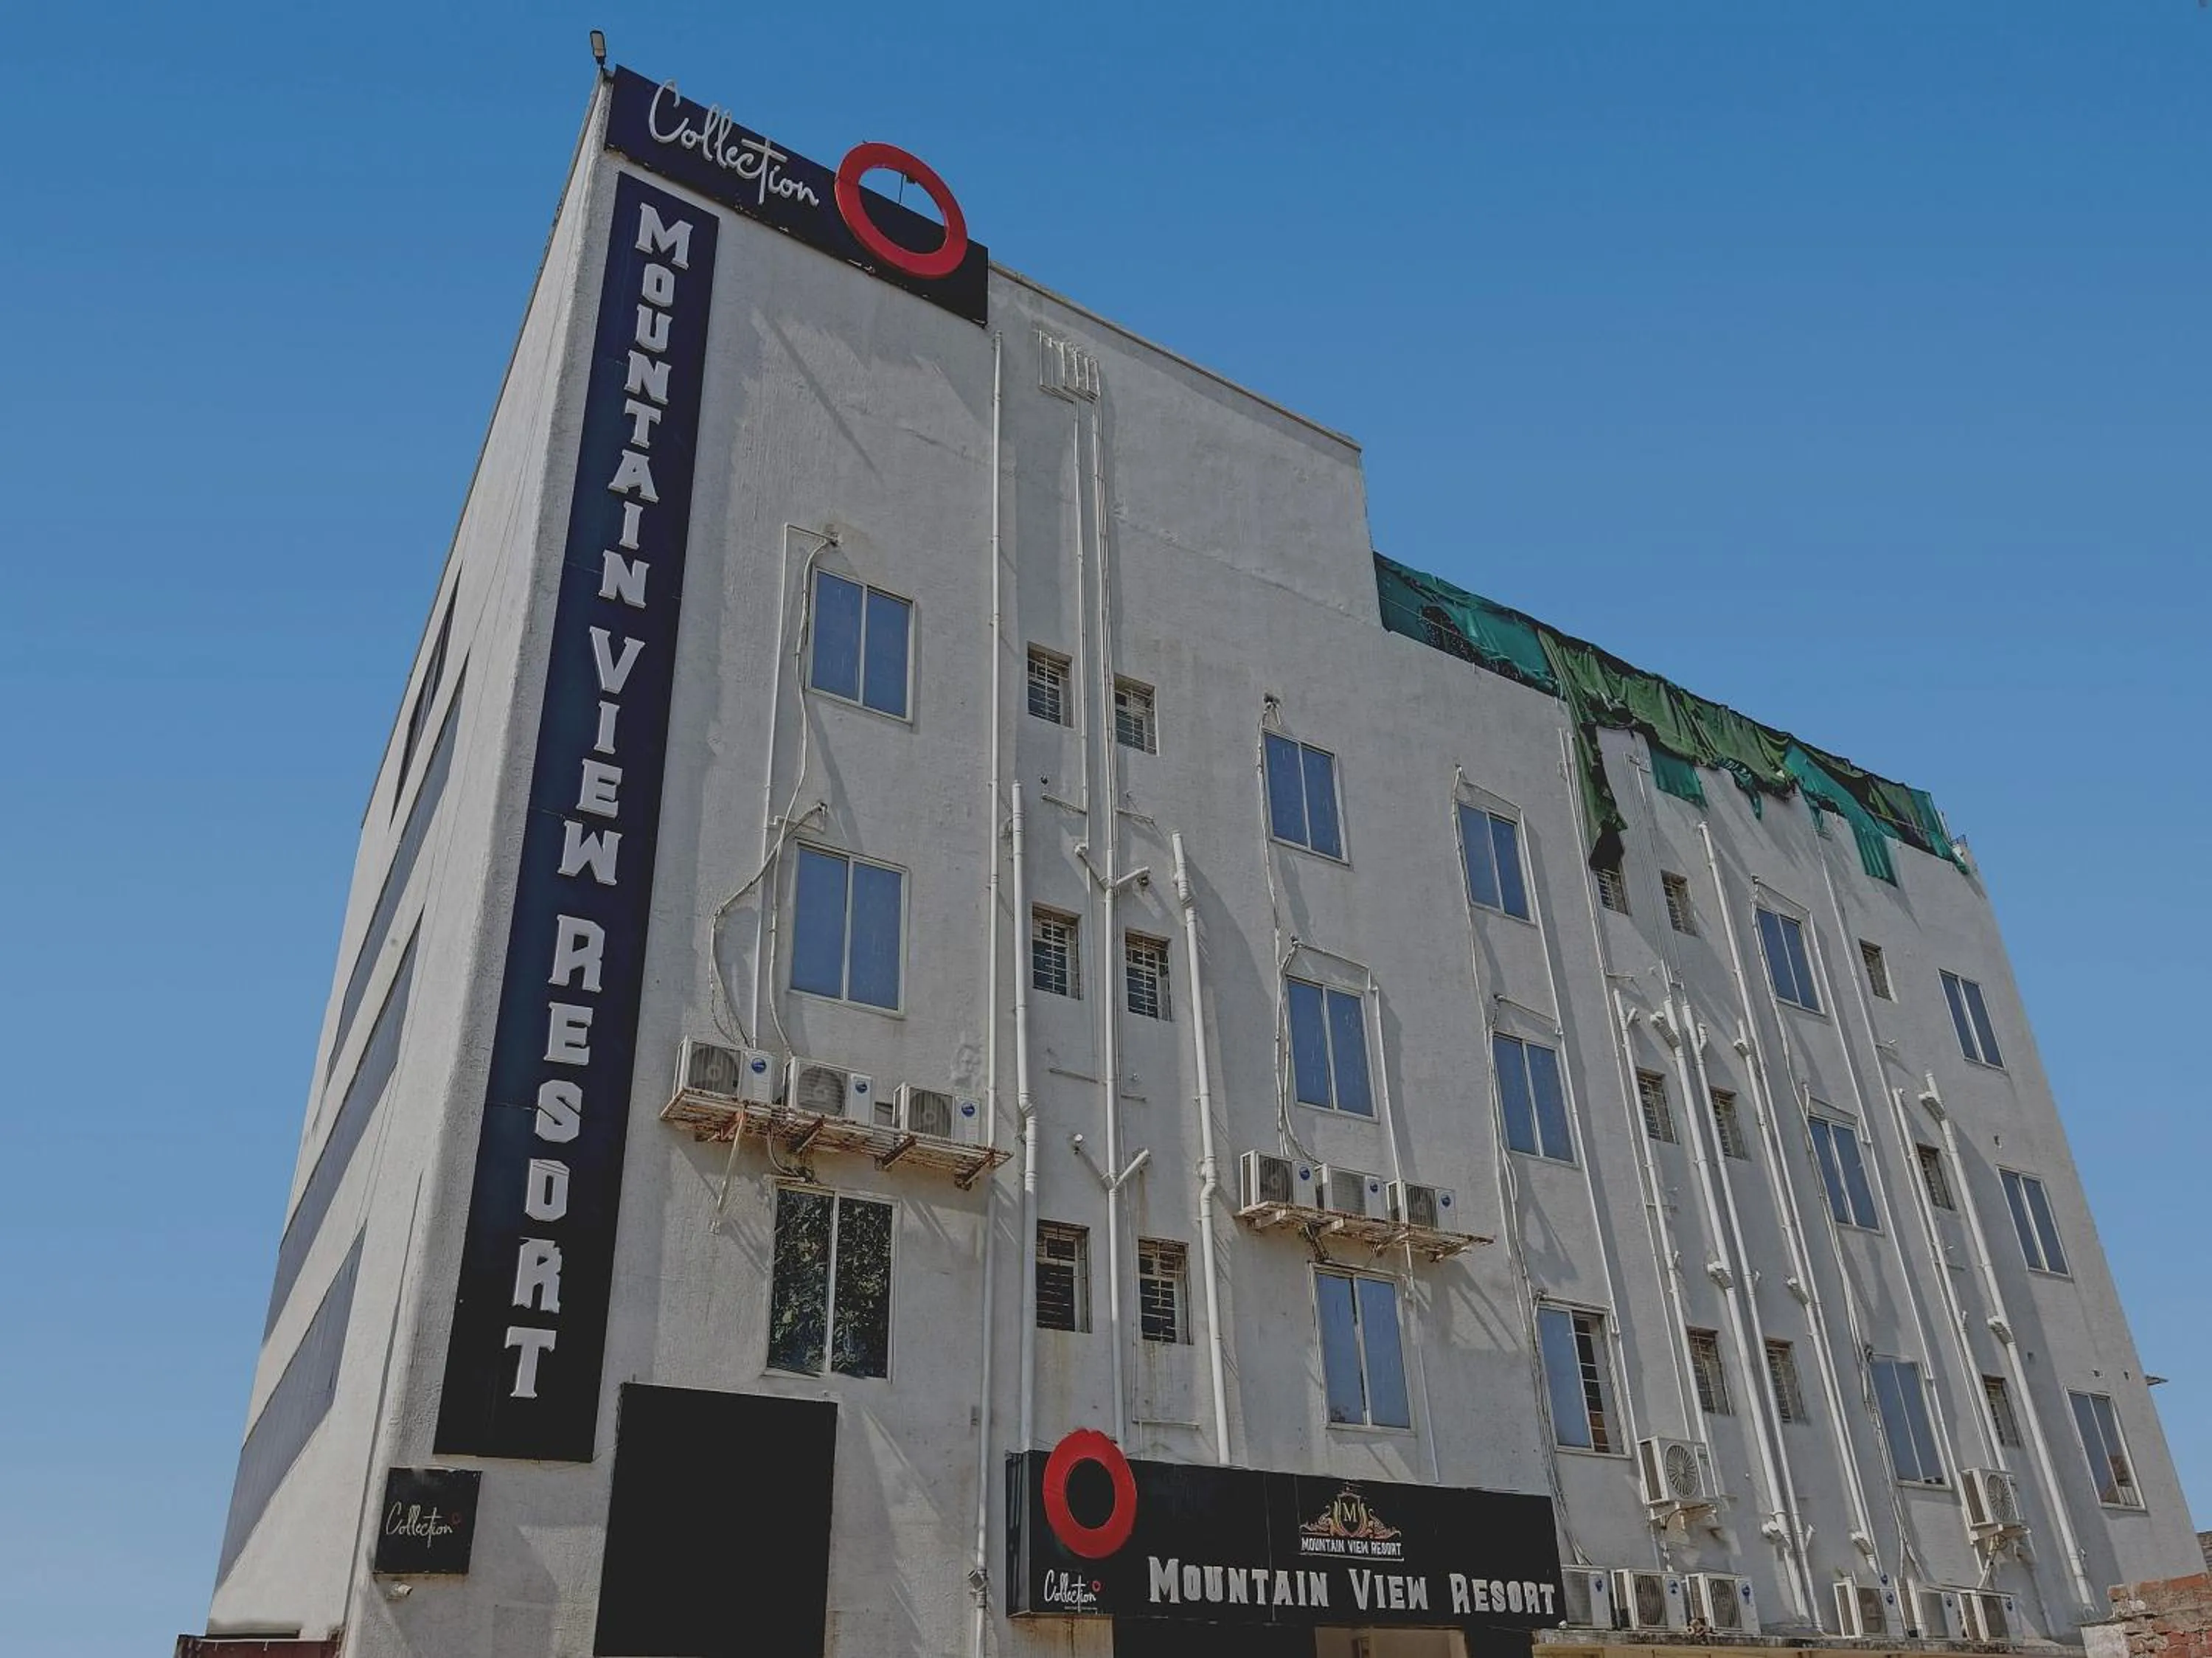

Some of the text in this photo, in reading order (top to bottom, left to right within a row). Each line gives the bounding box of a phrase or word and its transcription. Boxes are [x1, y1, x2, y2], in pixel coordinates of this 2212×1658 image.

[648, 78, 820, 206] Collection
[504, 202, 693, 1399] MOUNTAIN VIEW RESORT
[386, 1501, 453, 1549] Collection
[1301, 1537, 1402, 1556] MOUNTAIN VIEW RESORT
[1044, 1569, 1096, 1614] Collection
